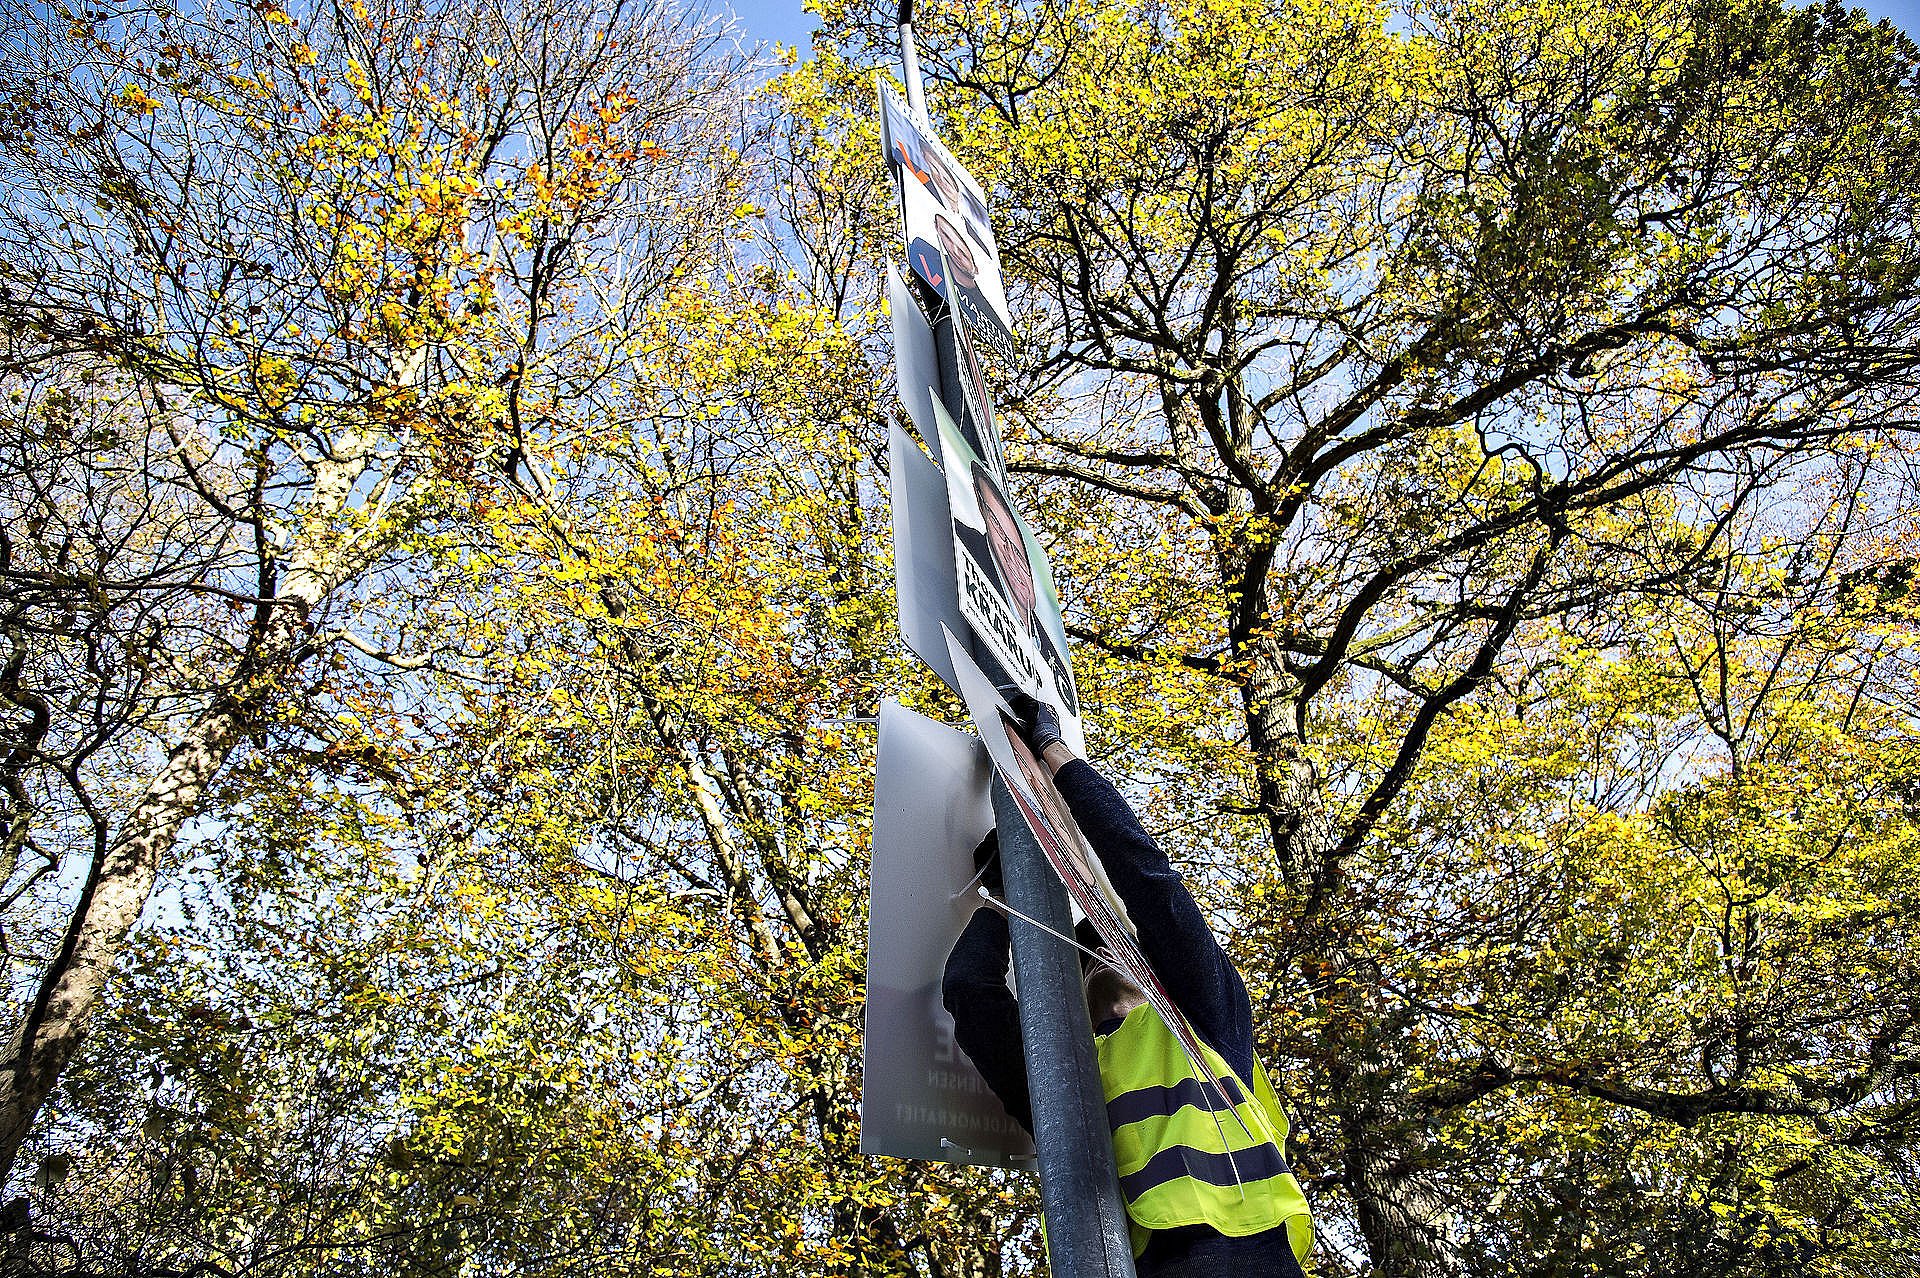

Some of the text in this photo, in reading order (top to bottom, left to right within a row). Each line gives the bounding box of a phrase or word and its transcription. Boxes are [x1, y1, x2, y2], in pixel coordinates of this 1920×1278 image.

[953, 284, 1014, 353] MARTIN
[976, 314, 1015, 363] BECH
[962, 551, 1016, 636] Thomas
[965, 571, 1043, 690] KRARUP
